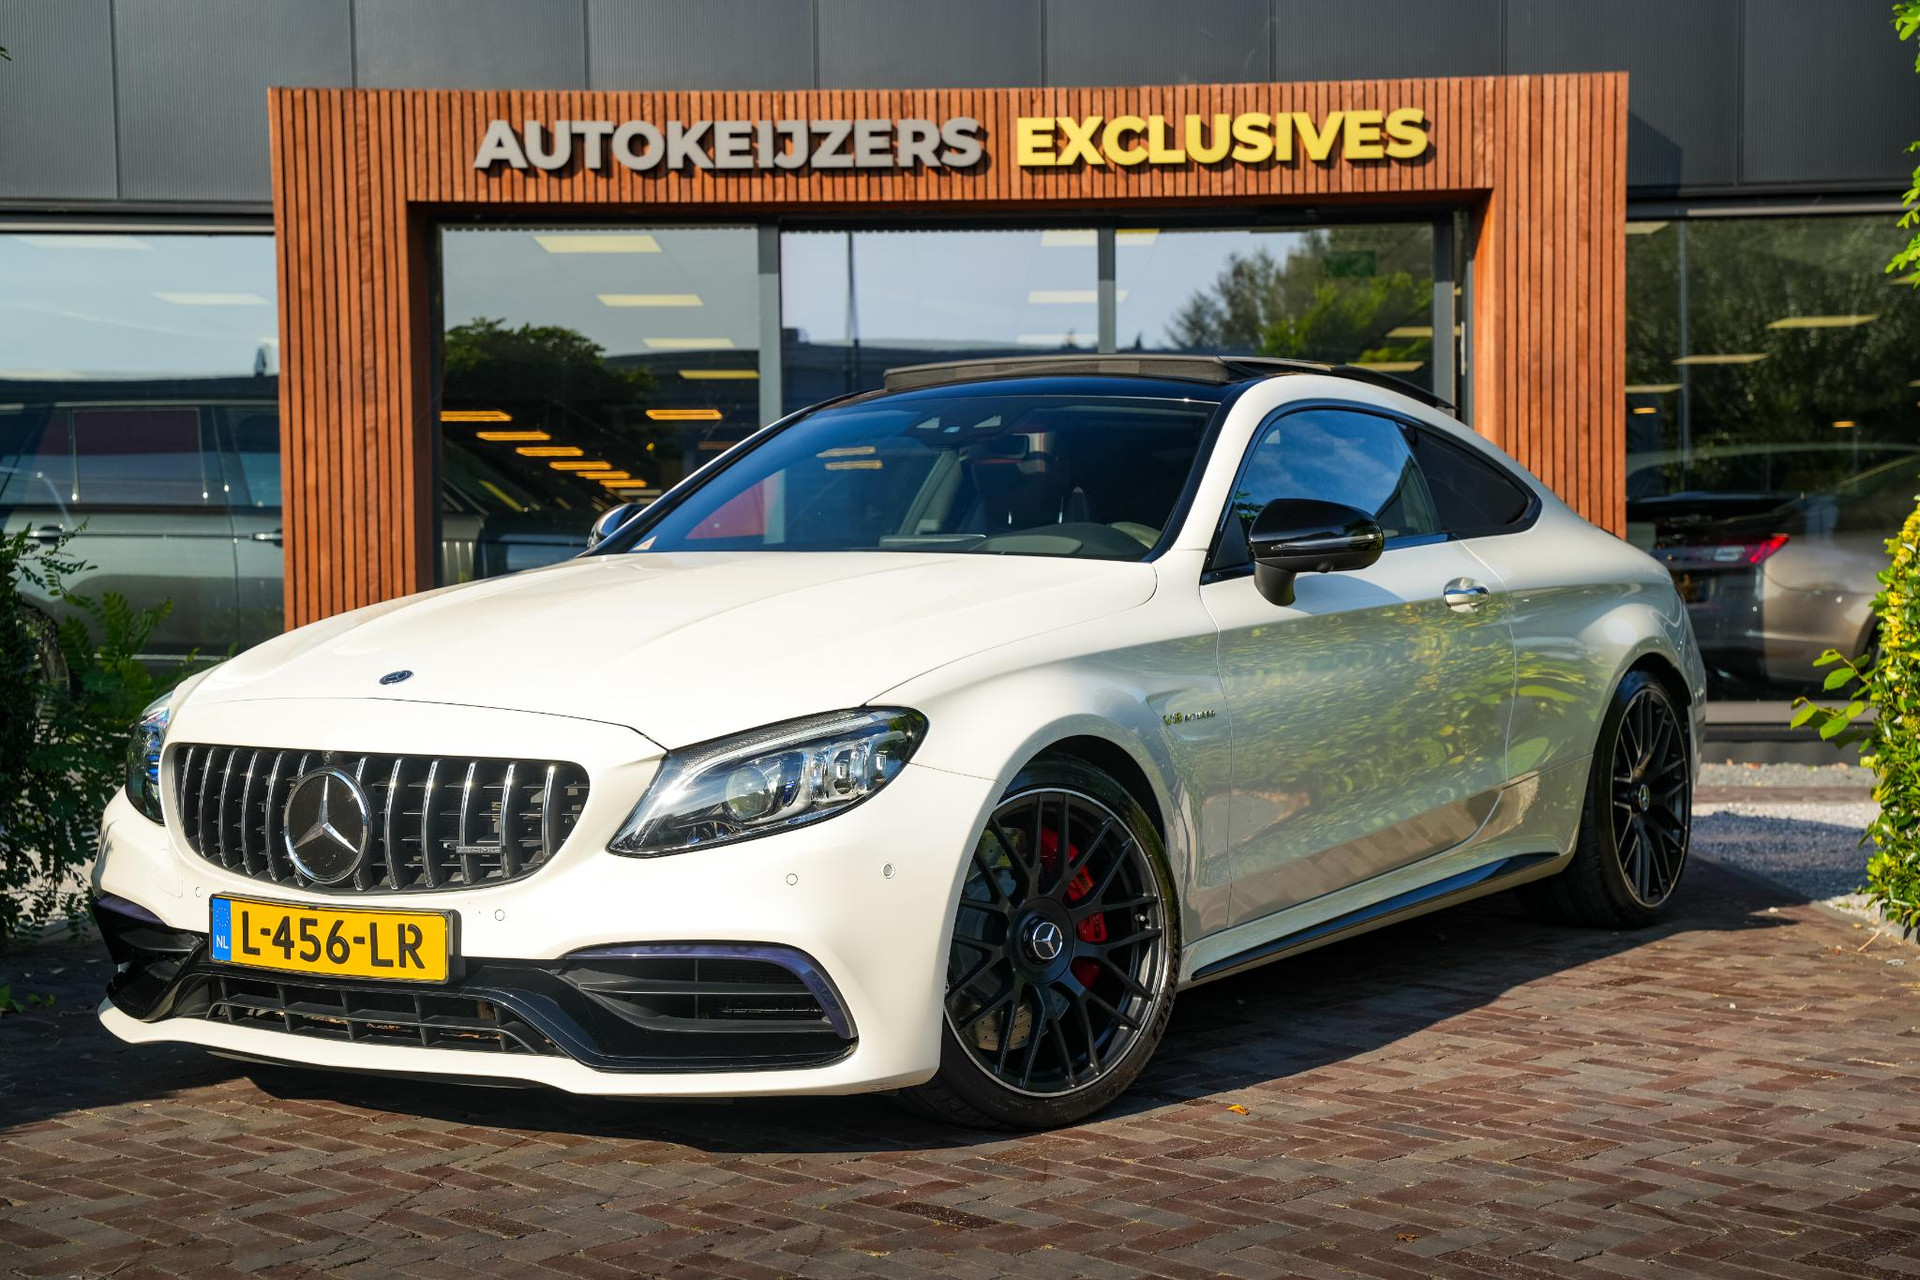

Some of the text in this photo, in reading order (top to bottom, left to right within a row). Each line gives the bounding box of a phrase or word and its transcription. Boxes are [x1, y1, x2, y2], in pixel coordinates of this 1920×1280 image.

[473, 108, 1429, 170] AUTOKEIJZERS EXCLUSIVES
[216, 934, 229, 950] NL
[241, 910, 425, 969] L-456-LR
